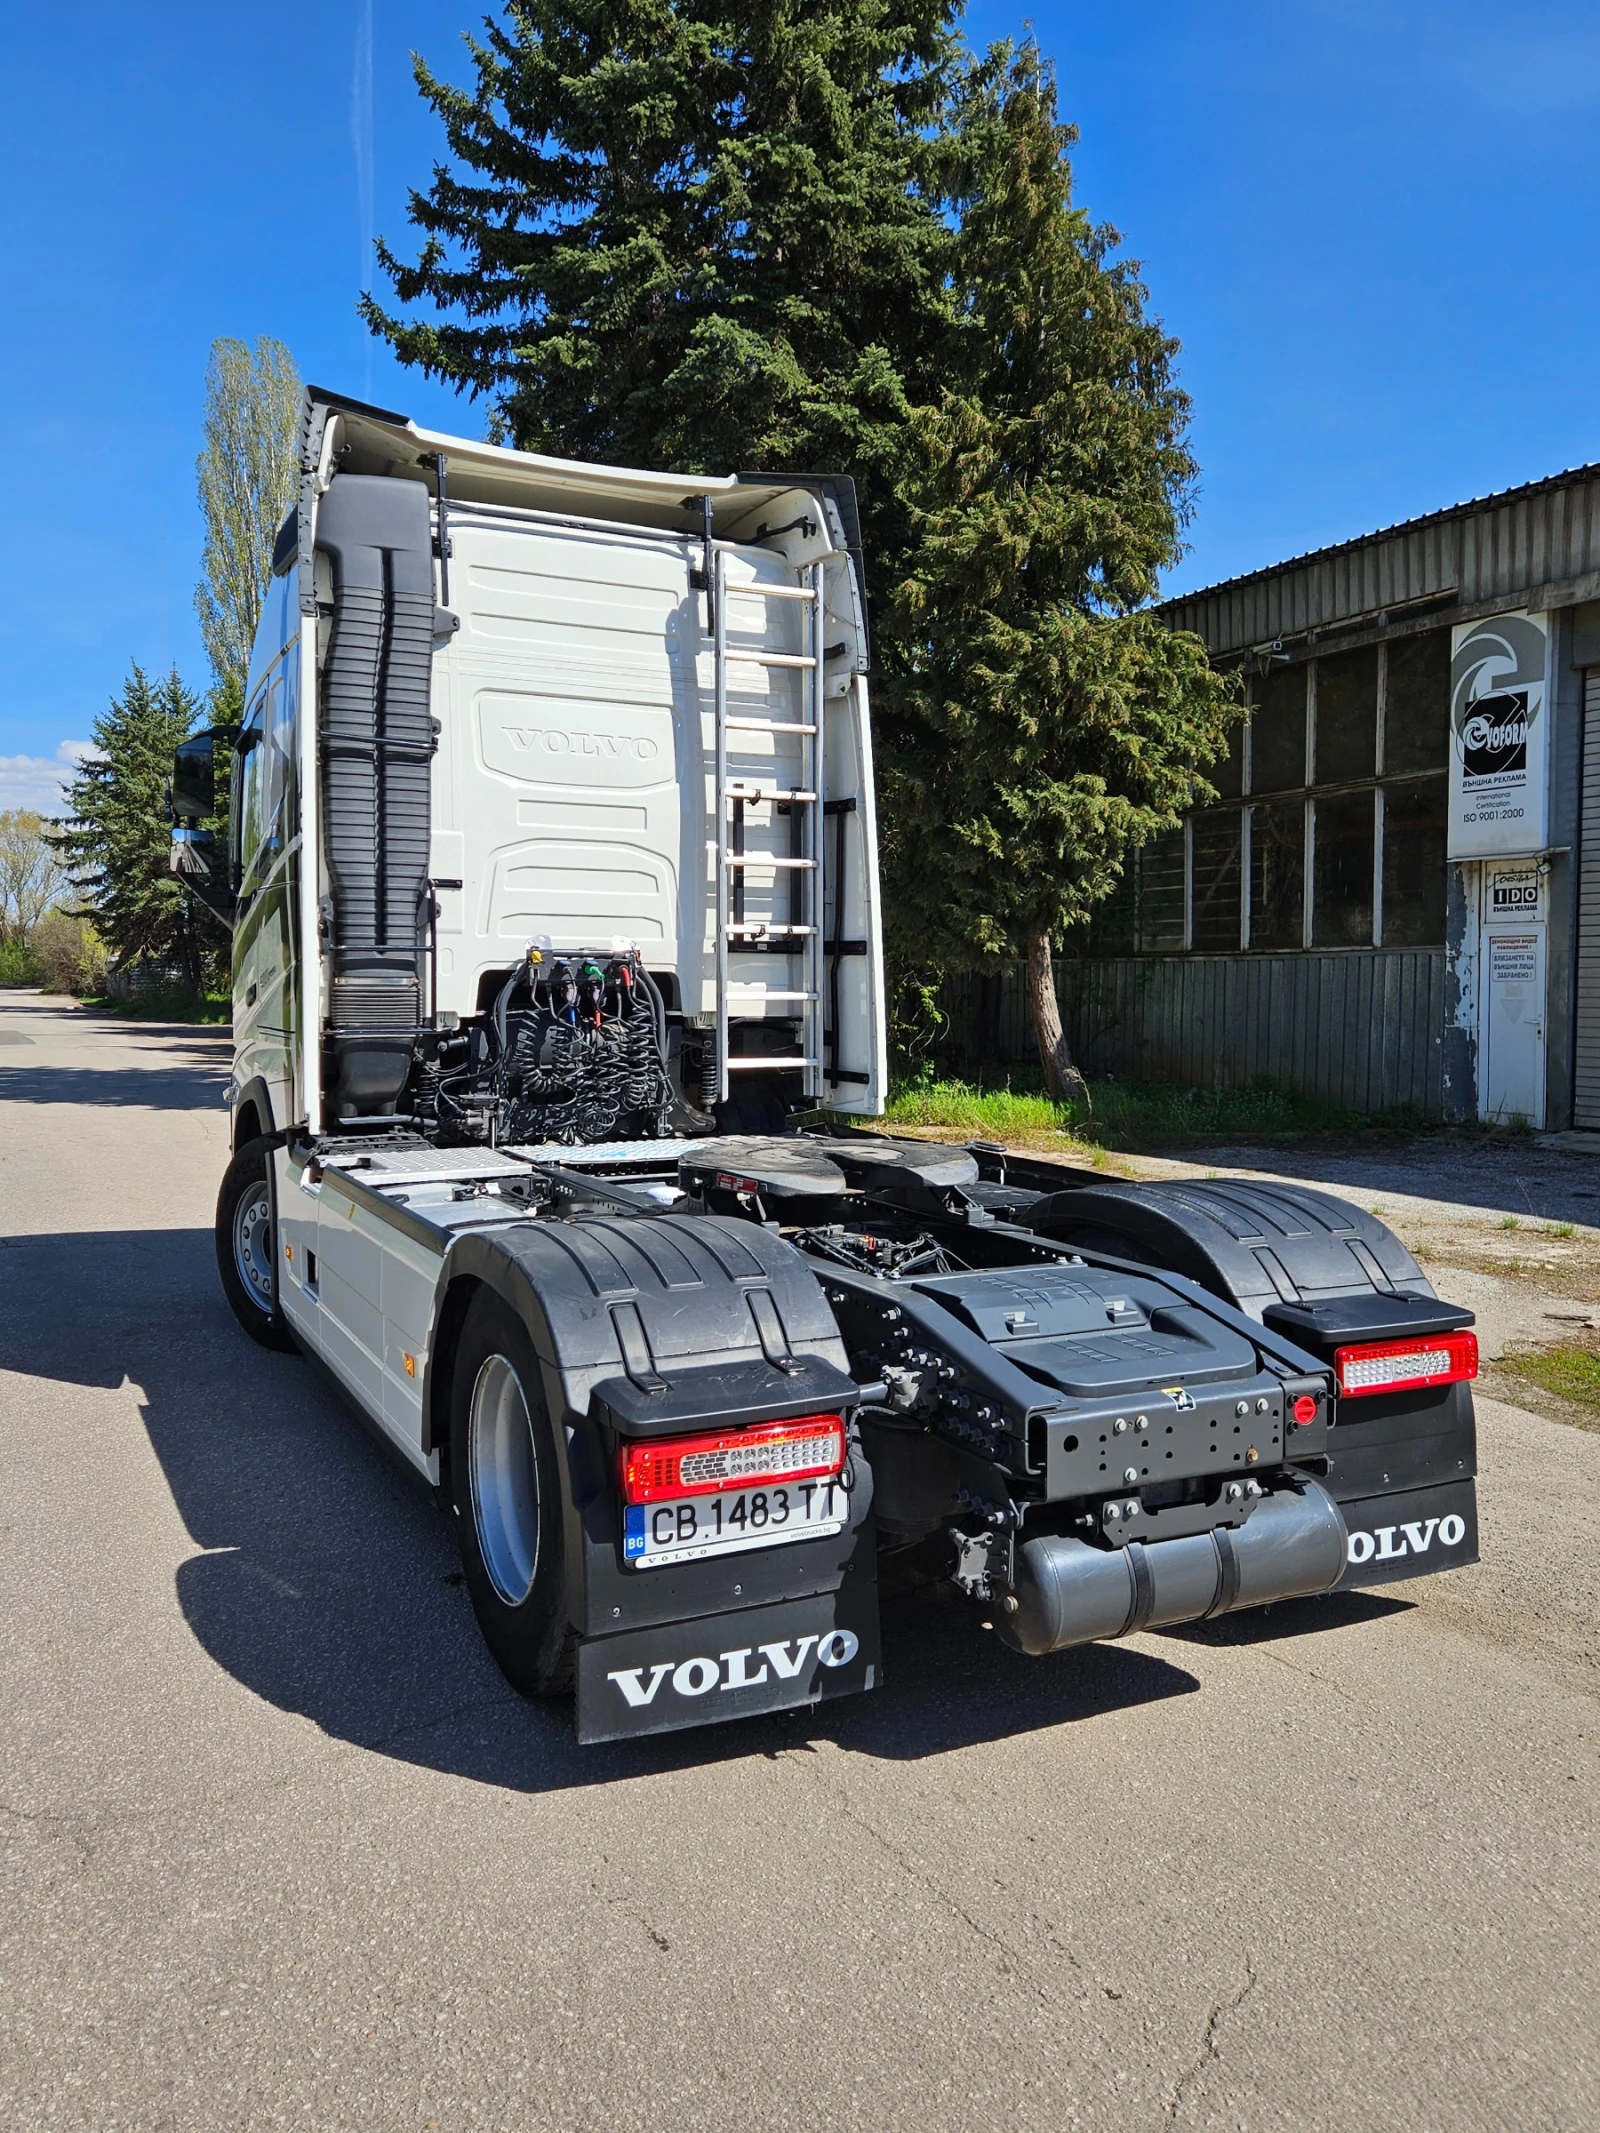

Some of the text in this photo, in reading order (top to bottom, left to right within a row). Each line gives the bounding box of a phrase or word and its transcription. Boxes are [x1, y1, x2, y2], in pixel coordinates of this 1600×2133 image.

[501, 726, 658, 762] VOLVO
[1463, 774, 1526, 788] ВЪНШНА РЕКЛАМА
[1476, 800, 1511, 810] Certification
[1463, 808, 1524, 823] ISO 9001:2000
[1498, 888, 1536, 903] IDO
[710, 1489, 790, 1535] 1483
[627, 1535, 644, 1550] BG
[1347, 1514, 1465, 1564] OLVO
[648, 1549, 707, 1564] VOLVO
[607, 1629, 859, 1707] VOLVO
